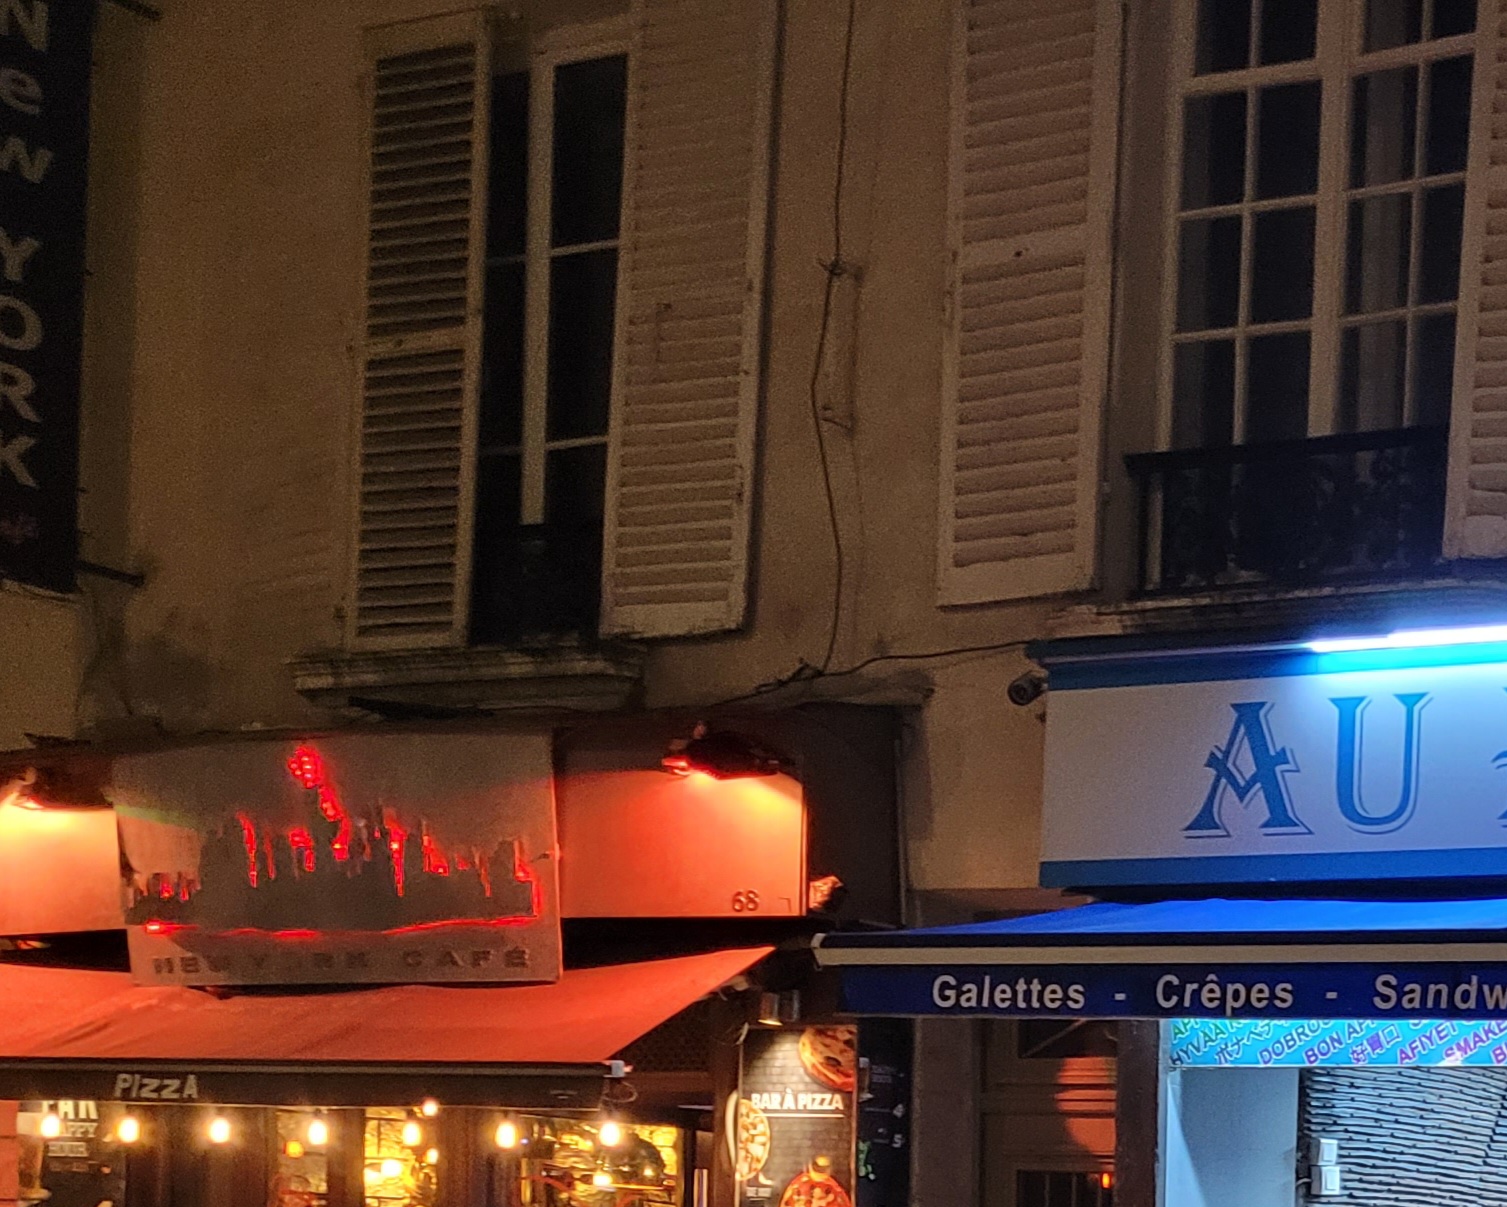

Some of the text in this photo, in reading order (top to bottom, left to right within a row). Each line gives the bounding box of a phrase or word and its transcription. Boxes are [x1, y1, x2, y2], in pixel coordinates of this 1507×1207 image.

[1182, 691, 1433, 842] AU
[732, 889, 761, 913] 68
[403, 946, 530, 970] CAFÉ
[932, 974, 1086, 1010] Galettes
[1156, 972, 1294, 1017] Crêpes
[1304, 1031, 1344, 1064] BON
[751, 1088, 844, 1110] BAR À PIZZA
